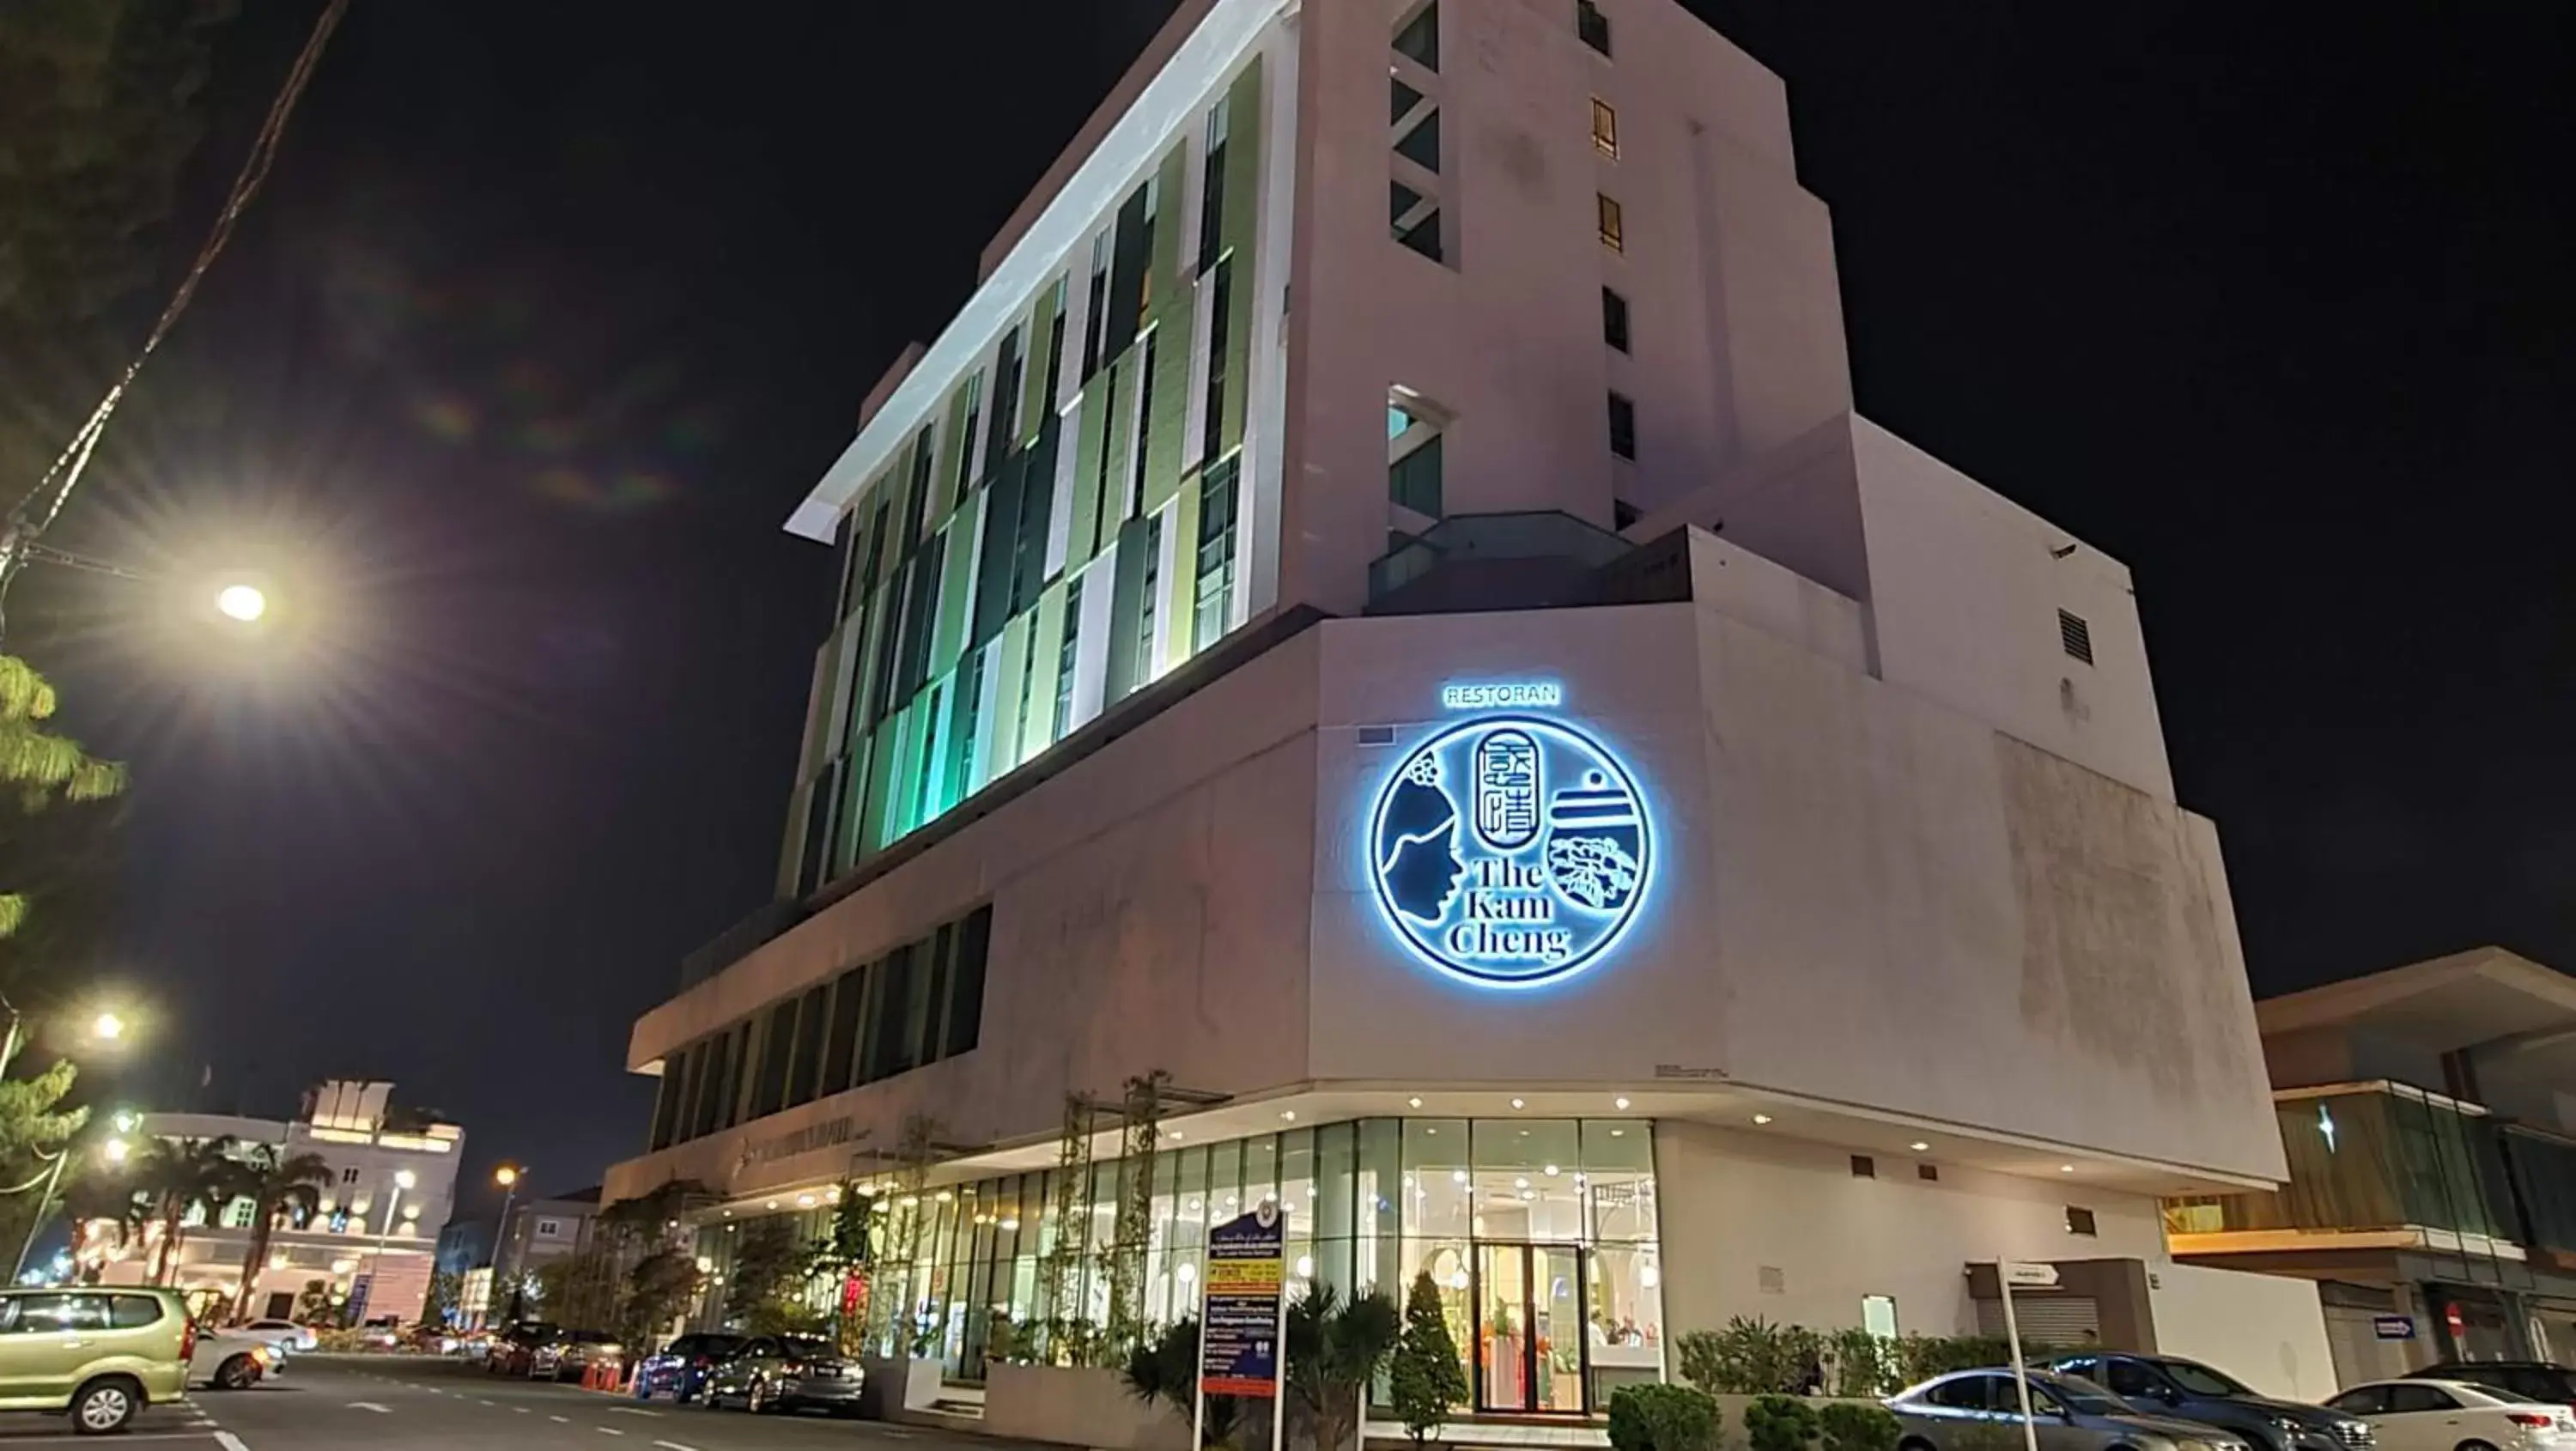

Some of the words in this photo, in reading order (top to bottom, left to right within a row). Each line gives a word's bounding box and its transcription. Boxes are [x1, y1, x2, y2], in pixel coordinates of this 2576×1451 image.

[1446, 686, 1557, 703] RESTORAN
[1472, 857, 1543, 888] The
[1467, 891, 1550, 920] Kam
[1449, 923, 1570, 960] Cheng
